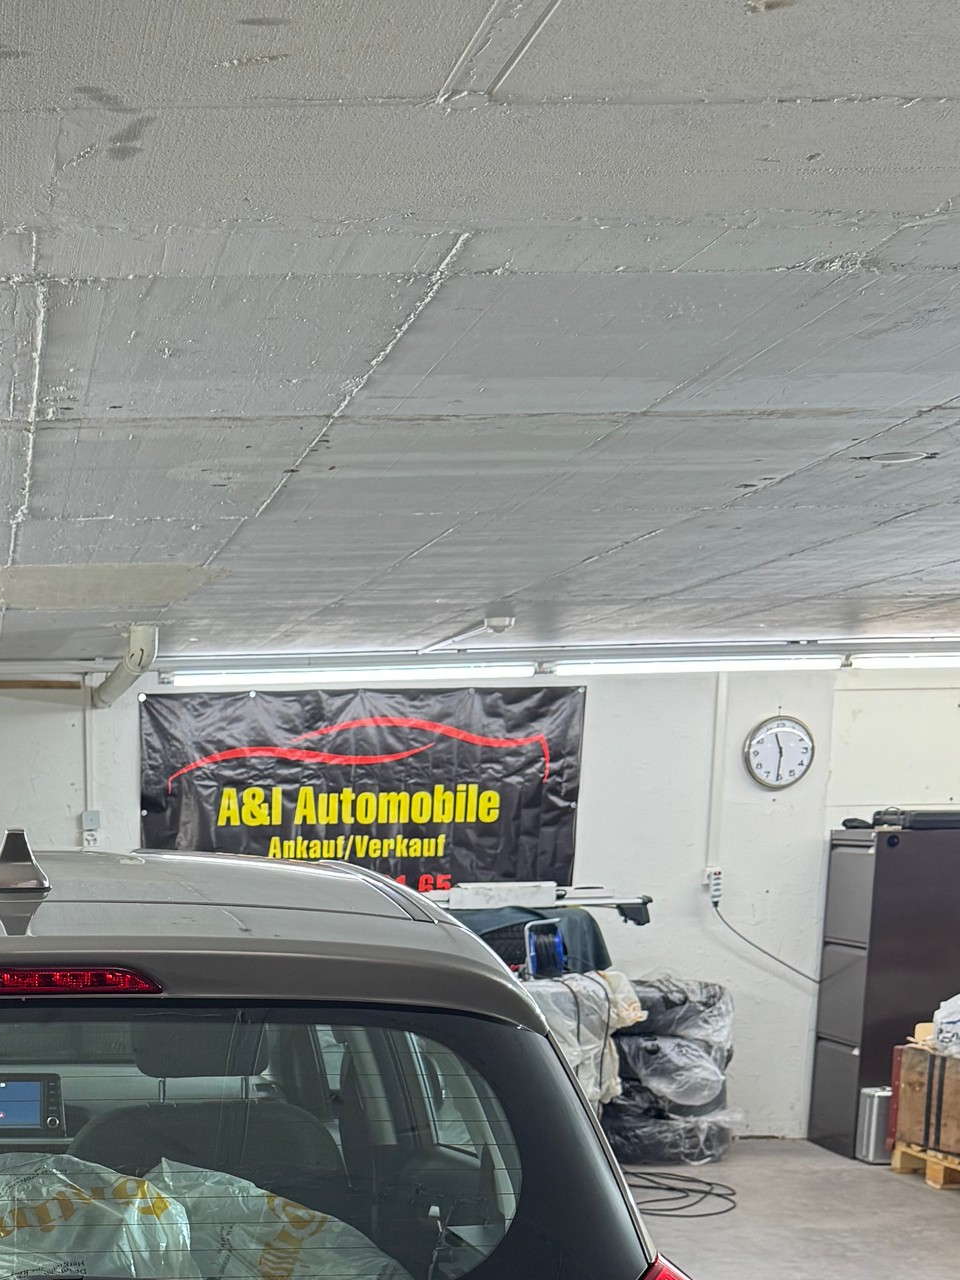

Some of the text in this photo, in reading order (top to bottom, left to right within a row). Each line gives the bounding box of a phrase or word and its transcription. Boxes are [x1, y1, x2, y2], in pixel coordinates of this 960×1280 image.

[217, 784, 500, 826] A&I Automobile
[268, 834, 446, 860] Ankauf/Verkauf
